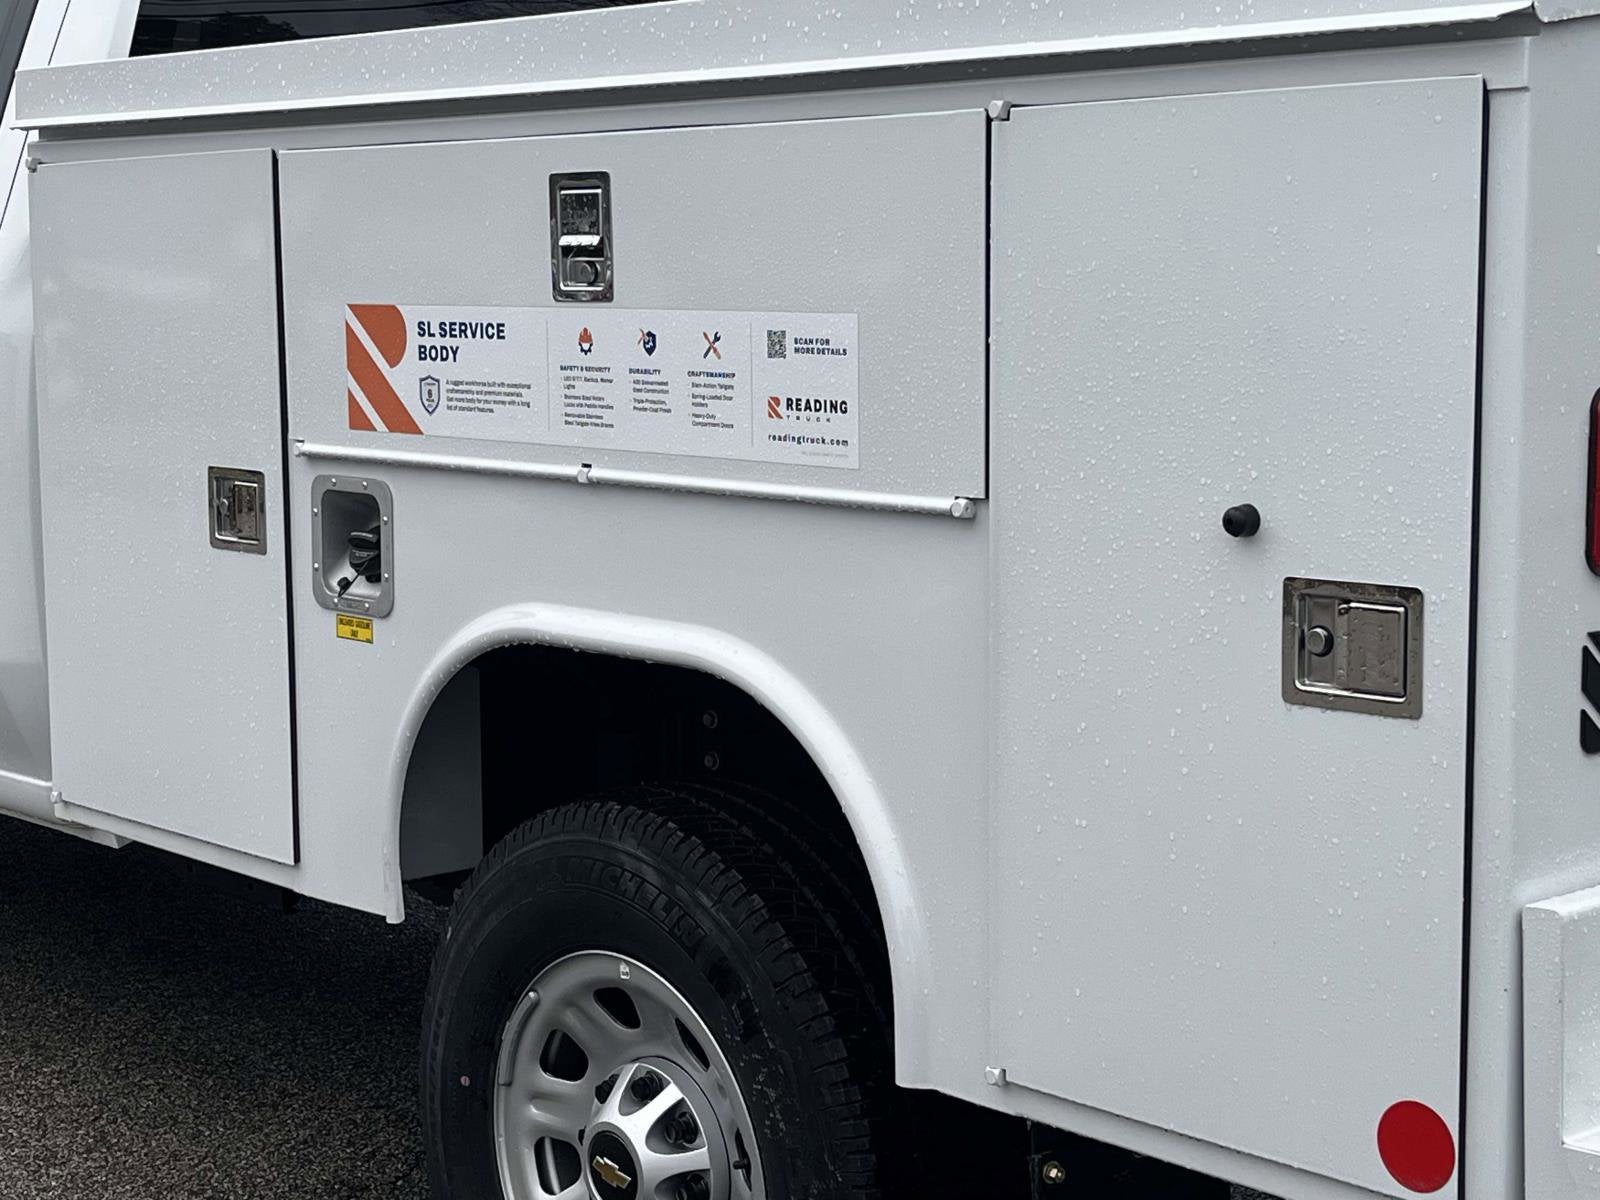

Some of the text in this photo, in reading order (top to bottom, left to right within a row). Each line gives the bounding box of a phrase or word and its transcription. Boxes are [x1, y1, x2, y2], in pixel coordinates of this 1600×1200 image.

[417, 320, 506, 340] SL SERVICE
[794, 337, 830, 347] SCAN FOR
[418, 344, 460, 363] BODY
[794, 346, 848, 356] MORE DETAILS
[687, 370, 736, 378] CRAFTSMANSHIP
[786, 397, 848, 414] READING
[786, 414, 831, 423] TRUCK
[767, 434, 849, 447] readingtruck.com
